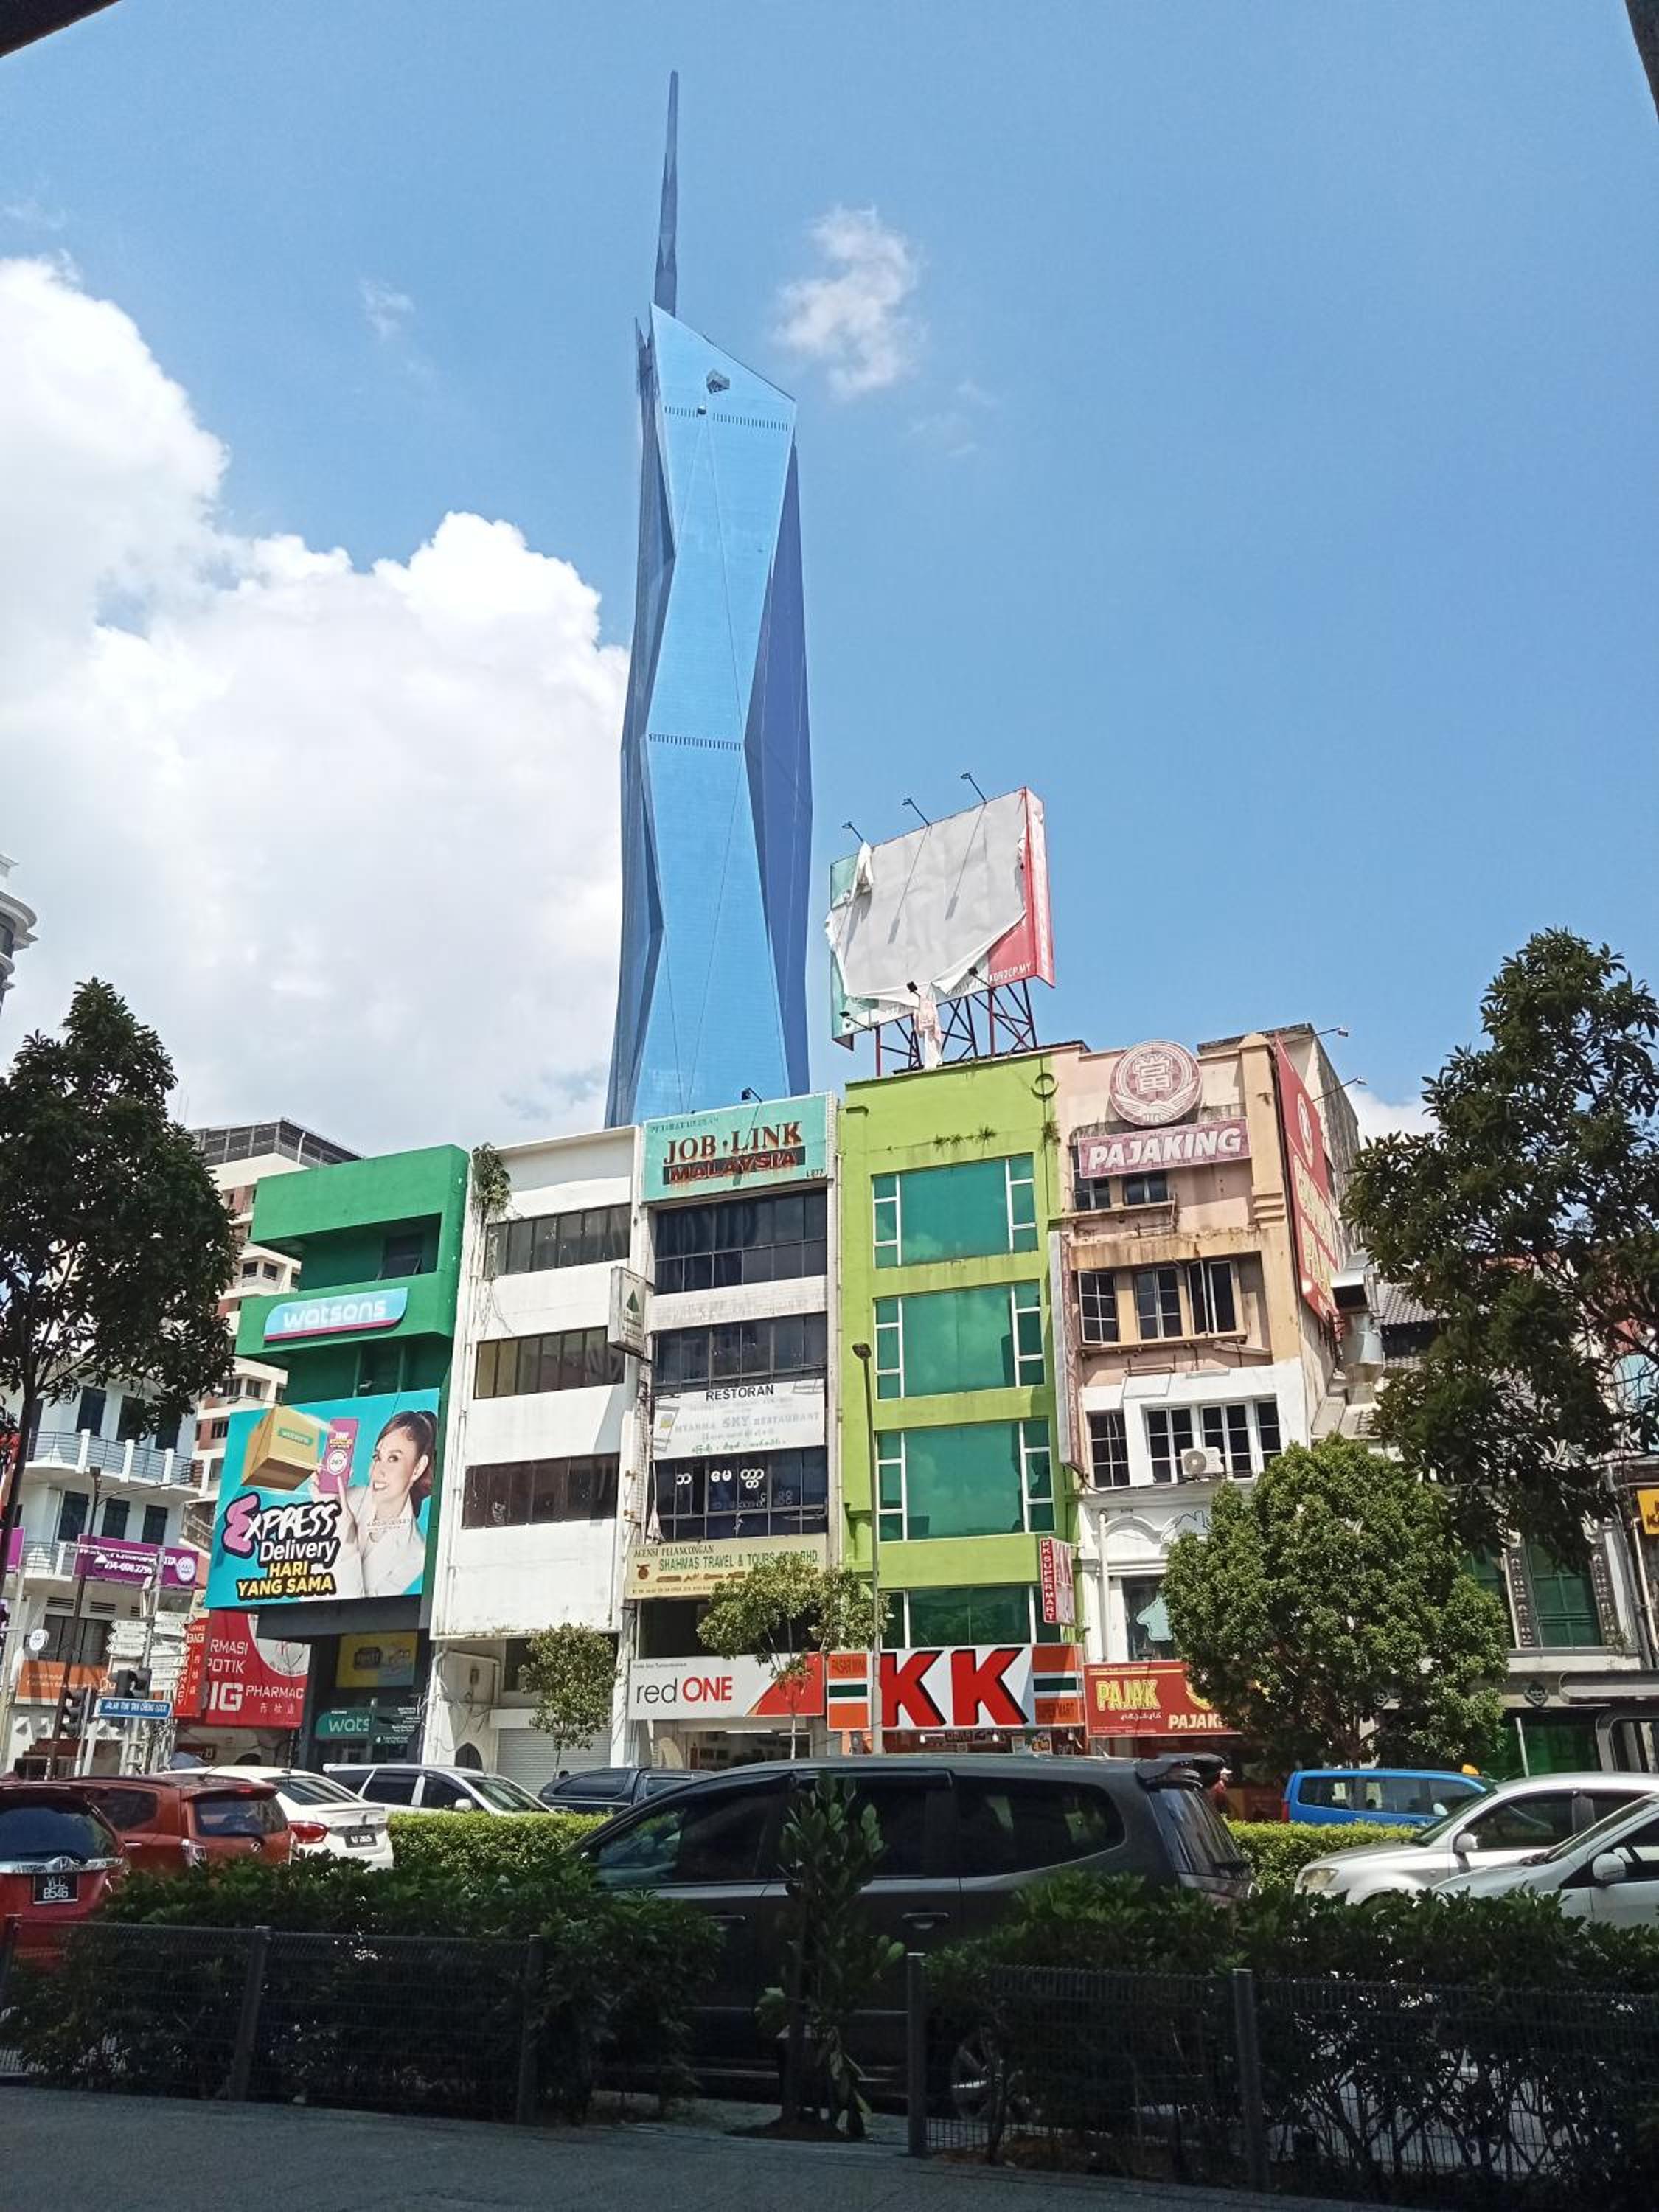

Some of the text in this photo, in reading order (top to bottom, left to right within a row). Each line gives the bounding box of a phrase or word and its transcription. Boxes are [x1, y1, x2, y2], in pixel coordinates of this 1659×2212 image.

[664, 1121, 802, 1164] JOB LINK
[1088, 1127, 1242, 1171] PAJAKING
[669, 1150, 797, 1183] MALAYSIA
[283, 1299, 387, 1328] watsons
[706, 1385, 774, 1402] RESTORAN
[260, 1540, 338, 1562] Delivery
[269, 1561, 308, 1578] HARI
[659, 1556, 700, 1571] SHAHMAS
[704, 1554, 734, 1569] TRAVEL
[237, 1576, 333, 1597] YANG SAMA
[210, 1639, 248, 1655] RMASI
[246, 1685, 305, 1700] PHARMAC
[328, 1716, 370, 1733] wats
[1168, 1712, 1222, 1730] PAJAK
